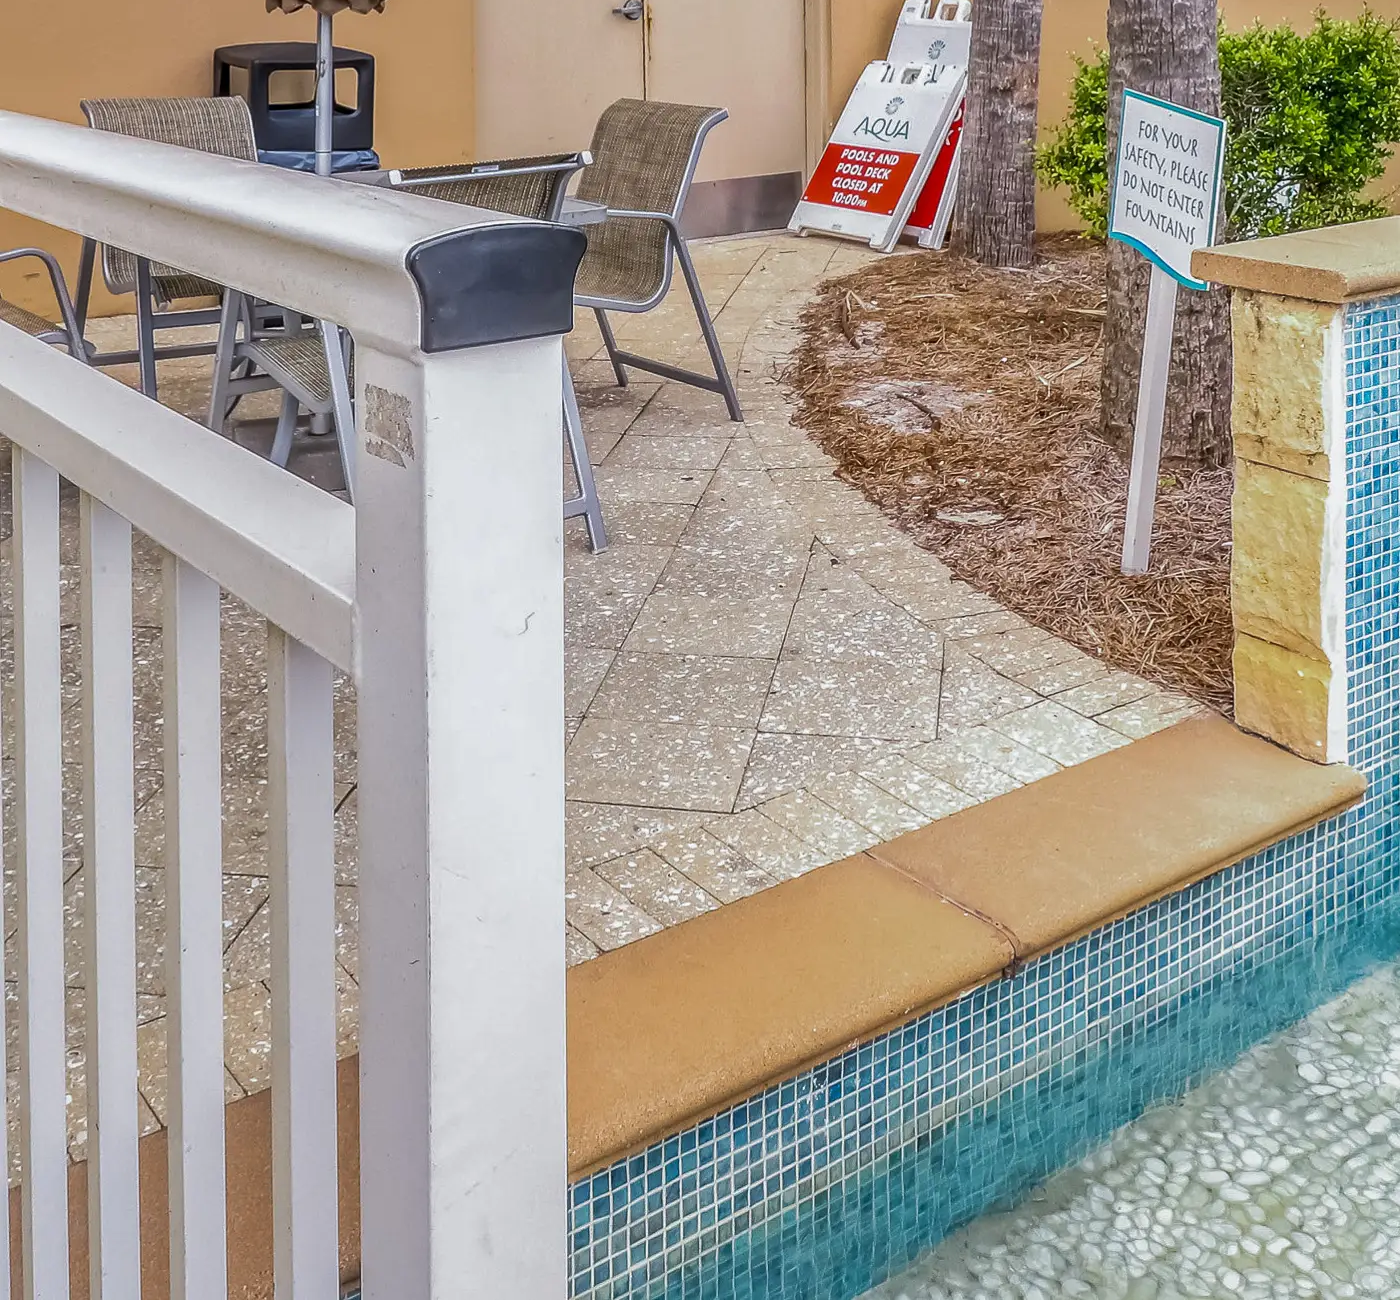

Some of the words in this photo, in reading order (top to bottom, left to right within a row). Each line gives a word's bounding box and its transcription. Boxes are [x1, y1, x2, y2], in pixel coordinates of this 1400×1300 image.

[853, 116, 909, 142] AQUA
[1138, 120, 1158, 143] FOR
[1162, 128, 1198, 157] YOUR
[835, 163, 863, 176] POOL
[864, 166, 892, 180] DECK
[841, 149, 875, 162] POOLS
[875, 153, 899, 166] AND
[1124, 142, 1167, 178] SAFETY,
[1171, 161, 1209, 192] PLEASE
[832, 177, 867, 191] CLOSED
[868, 183, 884, 194] AT
[1123, 170, 1137, 189] DO
[1141, 177, 1165, 203] NOT
[1167, 189, 1204, 220] ENTER
[1126, 200, 1195, 245] FOUNTAINS
